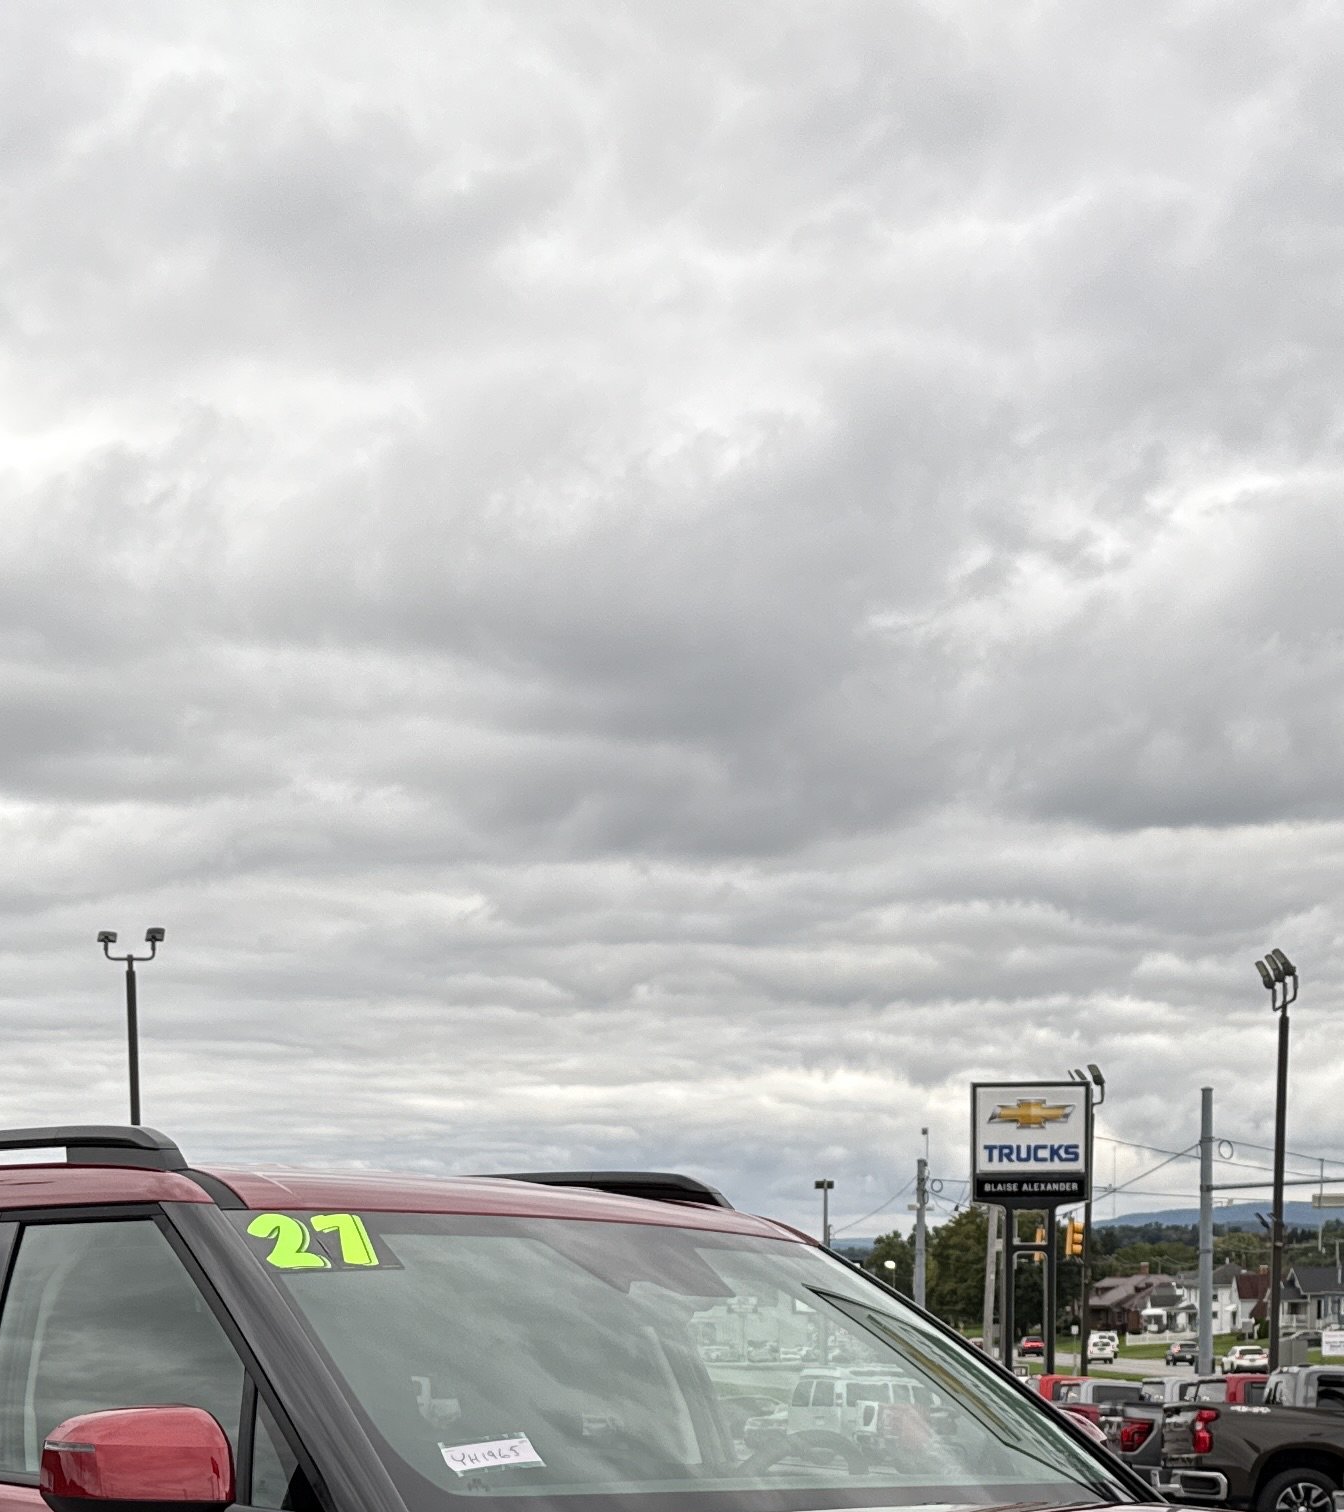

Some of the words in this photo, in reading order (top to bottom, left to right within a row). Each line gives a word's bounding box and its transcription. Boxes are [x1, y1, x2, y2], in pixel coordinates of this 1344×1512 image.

[983, 1143, 1080, 1163] TRUCKS
[983, 1182, 1018, 1192] BLAISE
[1022, 1182, 1079, 1192] ALEXANDER
[247, 1213, 379, 1269] 27
